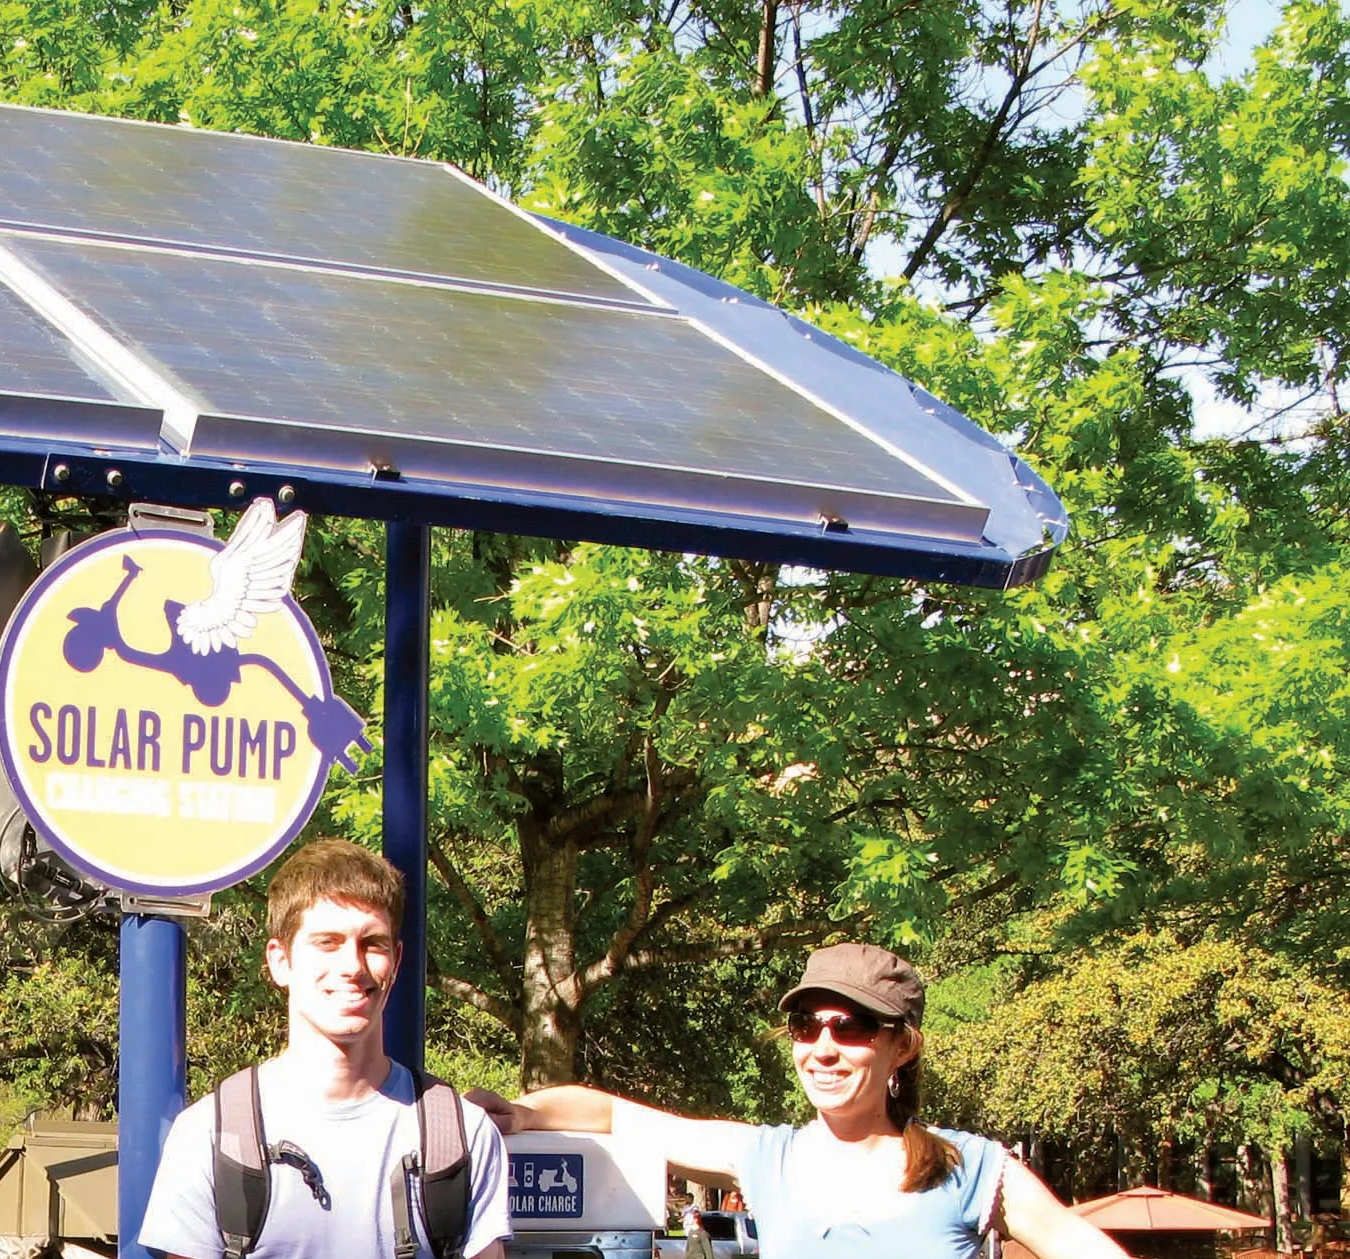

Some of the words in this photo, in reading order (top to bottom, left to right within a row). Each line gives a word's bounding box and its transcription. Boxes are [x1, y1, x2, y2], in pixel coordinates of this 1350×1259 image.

[28, 701, 162, 772] SOLAR
[182, 713, 297, 781] PUMP
[45, 771, 172, 818] CHAGG
[178, 779, 276, 824] STAT
[508, 1195, 535, 1213] OLAR
[537, 1195, 578, 1213] CHARGE
